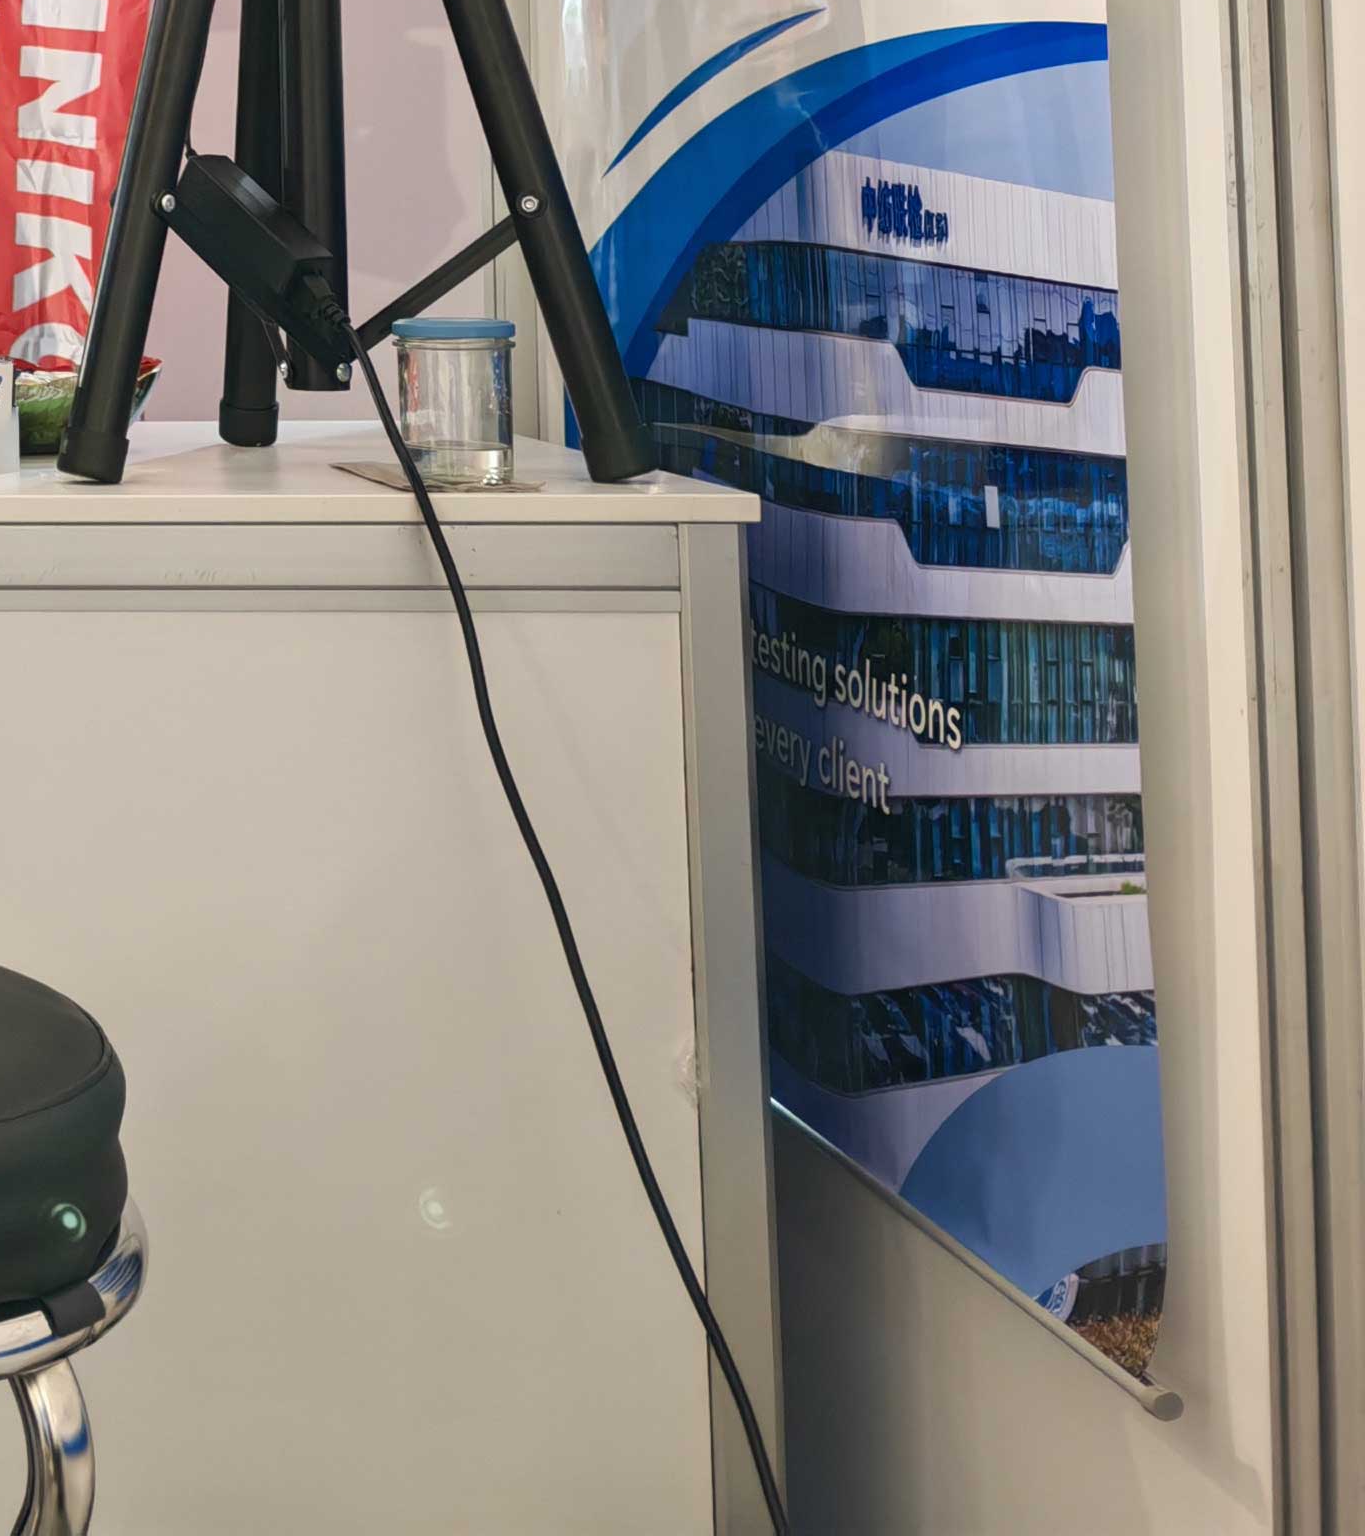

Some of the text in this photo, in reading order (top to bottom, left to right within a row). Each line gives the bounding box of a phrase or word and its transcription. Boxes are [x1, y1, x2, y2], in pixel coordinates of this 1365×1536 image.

[750, 619, 962, 750] testing solutions
[755, 715, 890, 815] every client
